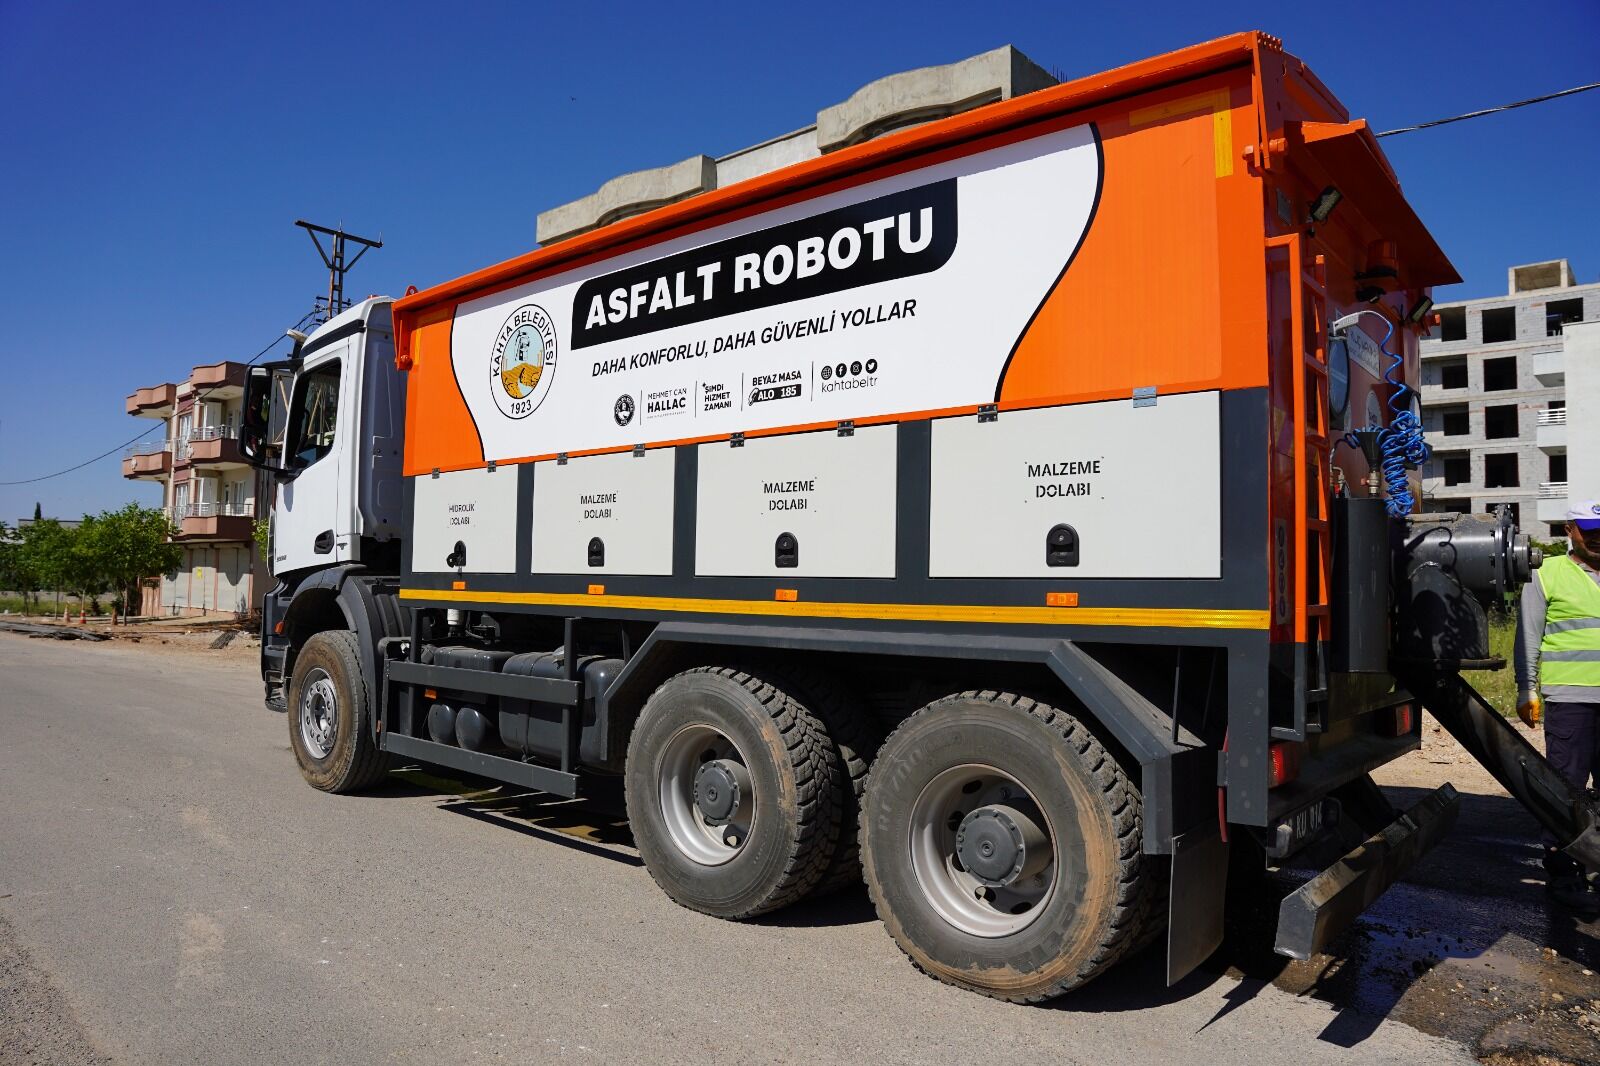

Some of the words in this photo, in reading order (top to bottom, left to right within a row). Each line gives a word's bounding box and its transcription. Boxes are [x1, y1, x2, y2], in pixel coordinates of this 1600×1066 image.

[585, 262, 721, 329] ASFALT
[734, 207, 933, 293] ROBOTU
[493, 325, 513, 377] KAHTA
[514, 311, 554, 366] BELEDİYESİ
[592, 353, 626, 377] DAHA
[629, 340, 709, 369] KONFORLU,
[713, 331, 756, 353] DAHA
[761, 310, 836, 344] GÜVENLİ
[841, 299, 917, 329] YOLLAR
[752, 373, 777, 386] BEYAZ
[778, 370, 802, 383] MASA
[821, 376, 878, 393] kahtabeltr
[648, 389, 672, 400] MEHMET
[673, 388, 687, 396] CAN
[757, 389, 775, 401] ALO
[780, 385, 797, 397] 185
[510, 400, 532, 414] 1923
[703, 400, 732, 411] ZAMANI
[1027, 460, 1101, 477] MALZEME
[763, 480, 815, 493] MALZEME
[1035, 482, 1091, 498] DOLABI
[580, 493, 617, 504] MALZEME
[769, 498, 808, 511] DOLABI
[584, 509, 611, 519] DOLABI
